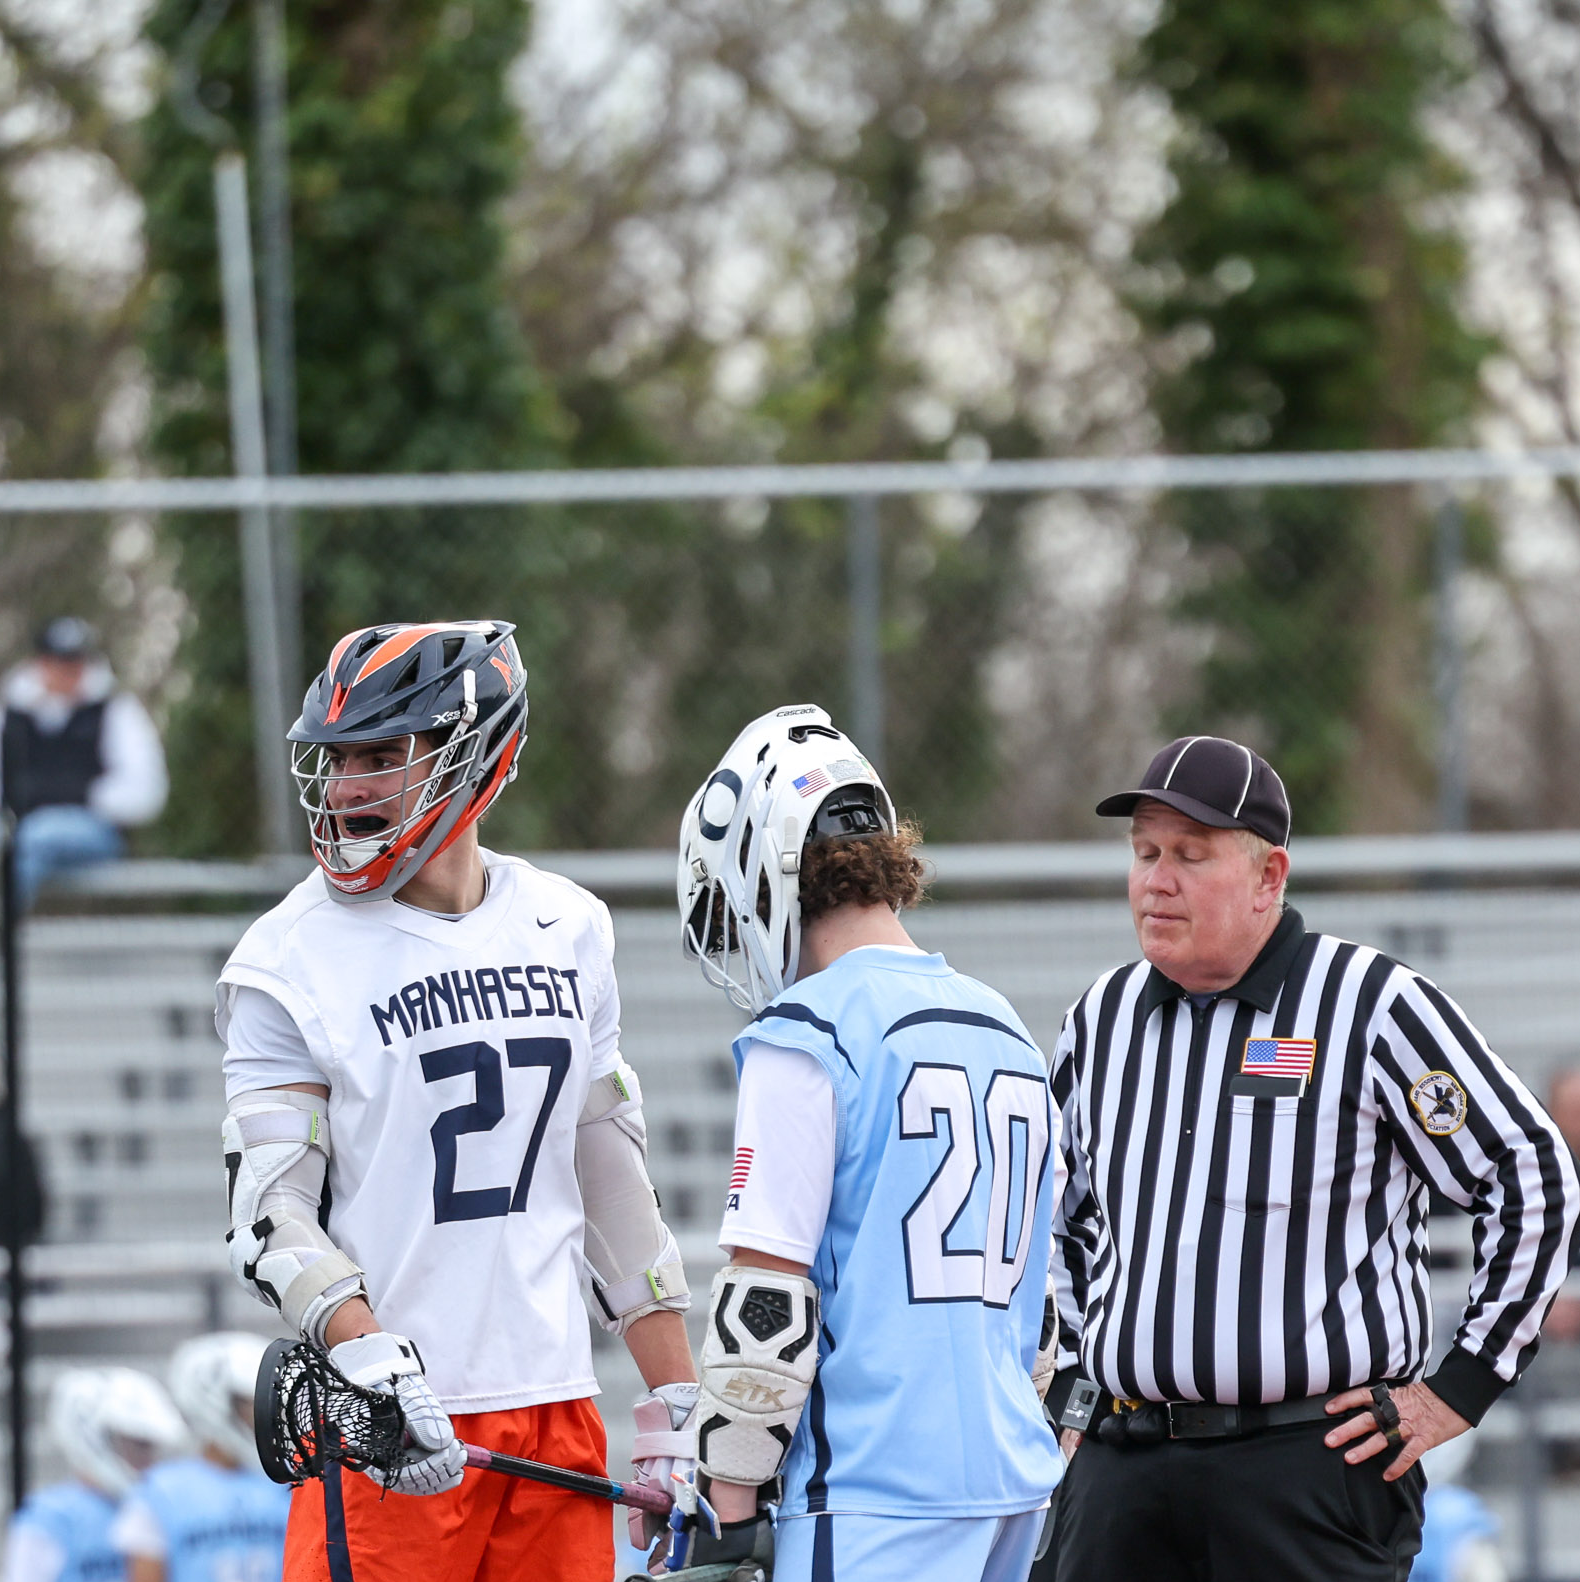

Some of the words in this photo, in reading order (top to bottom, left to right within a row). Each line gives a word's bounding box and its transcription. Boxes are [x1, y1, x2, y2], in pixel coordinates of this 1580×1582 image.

[776, 707, 817, 718] cascade
[370, 965, 584, 1046] MANHASSET
[419, 1037, 573, 1225] 27
[897, 1061, 1052, 1311] 20
[721, 1378, 786, 1411] STX
